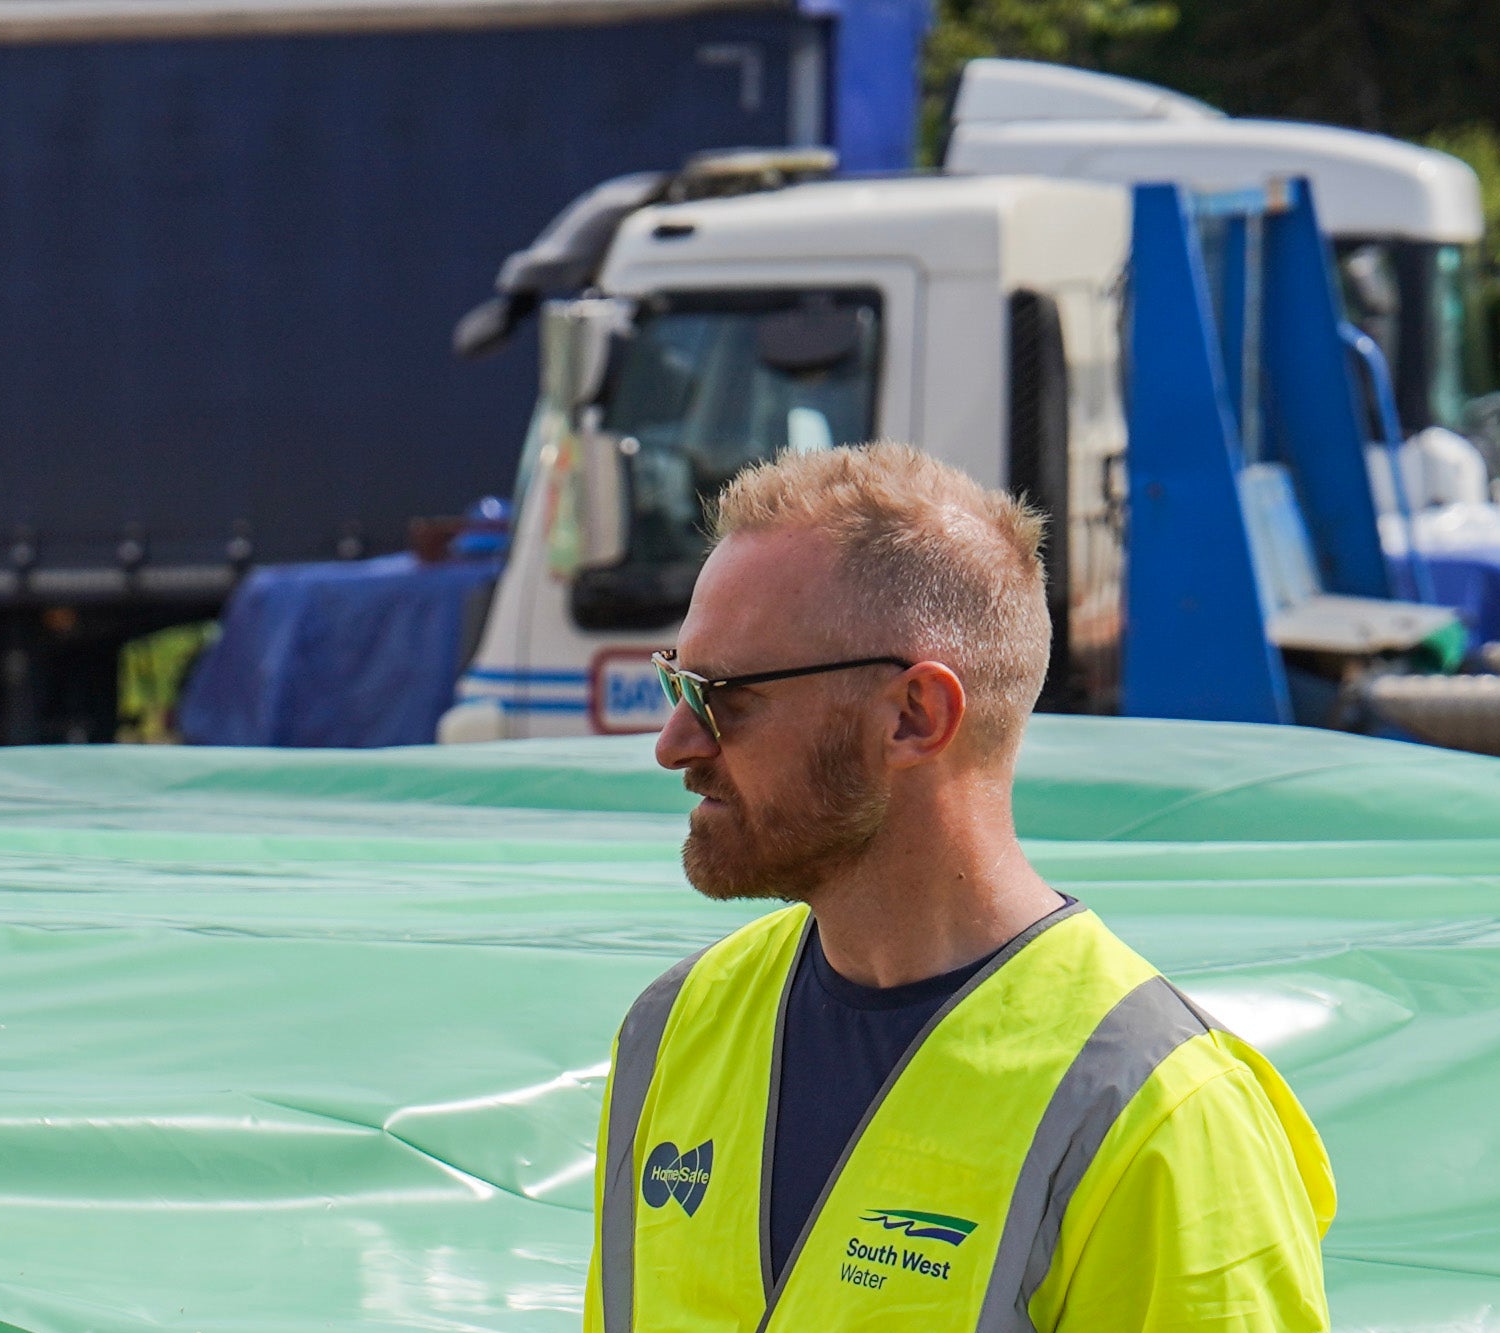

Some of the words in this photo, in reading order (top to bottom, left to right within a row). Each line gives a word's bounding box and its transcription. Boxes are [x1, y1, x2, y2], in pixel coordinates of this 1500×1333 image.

[651, 1165, 709, 1185] HomeSafe
[846, 1237, 898, 1266] South
[902, 1250, 951, 1280] West
[841, 1262, 888, 1290] Water
